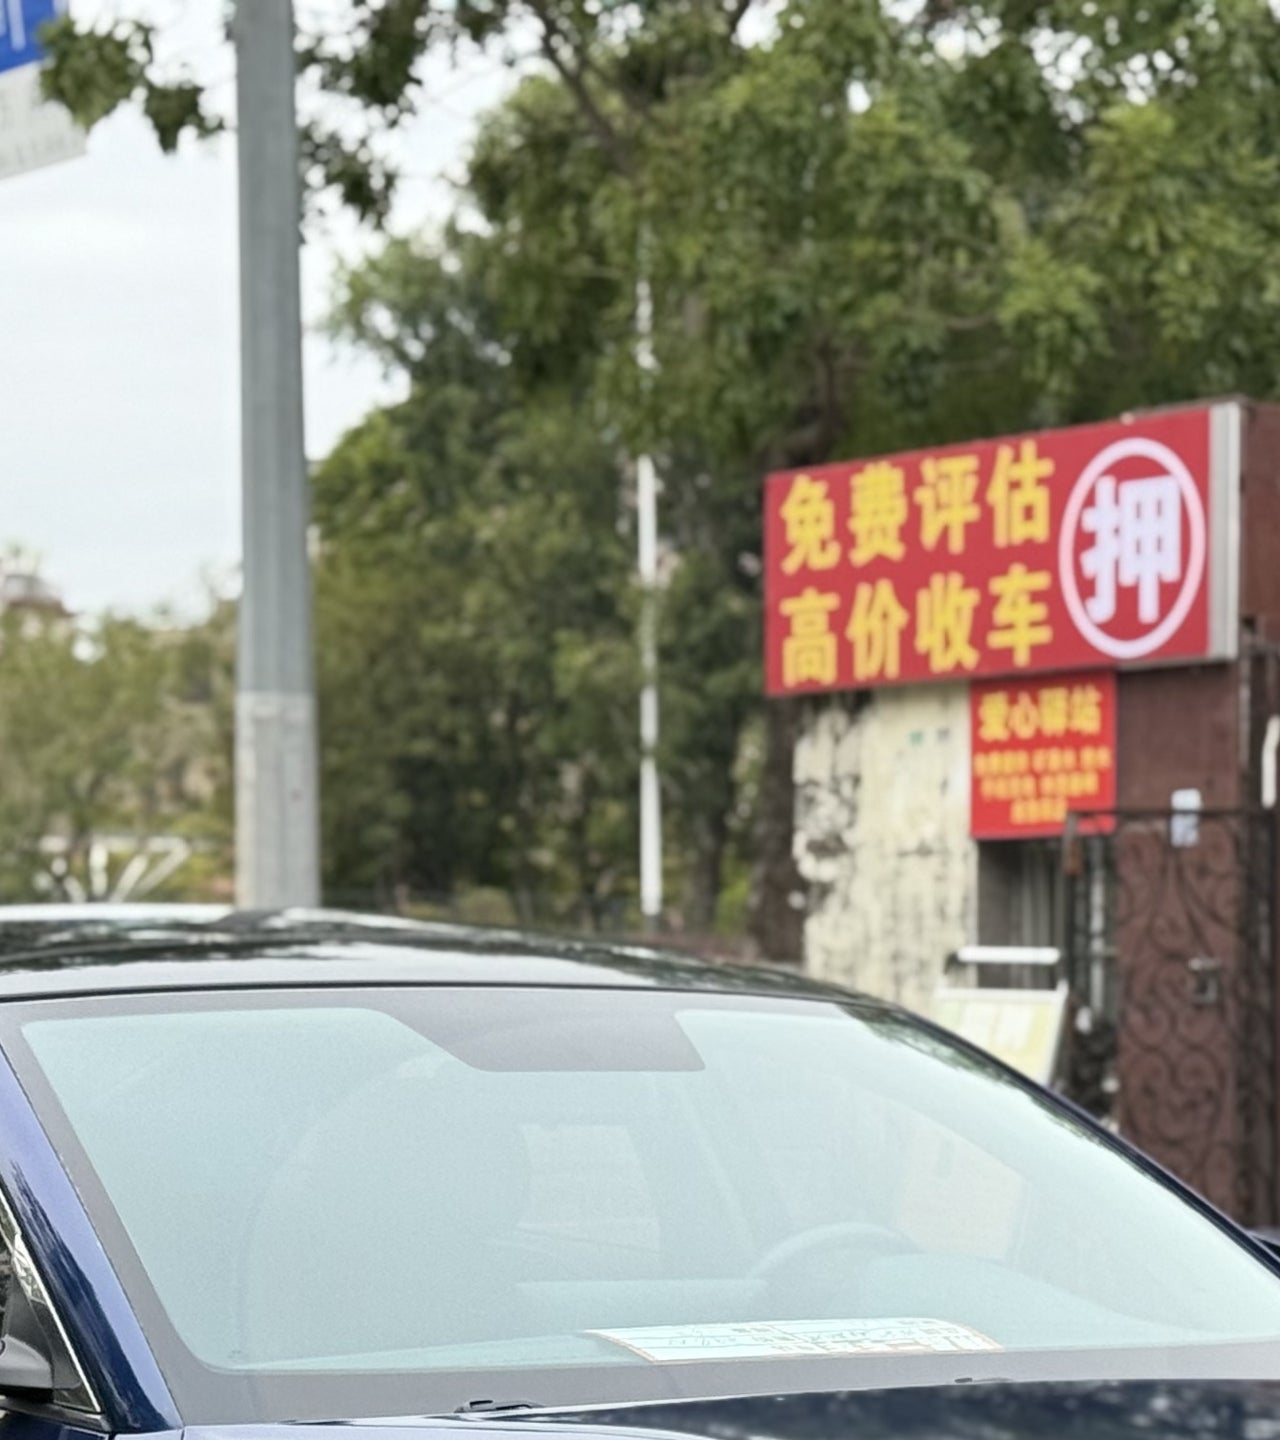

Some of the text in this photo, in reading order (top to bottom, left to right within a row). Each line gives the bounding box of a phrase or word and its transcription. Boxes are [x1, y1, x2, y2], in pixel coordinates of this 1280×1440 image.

[779, 441, 1054, 574] 免费评估
[1081, 475, 1182, 624] 押
[779, 564, 1053, 686] 高价收车
